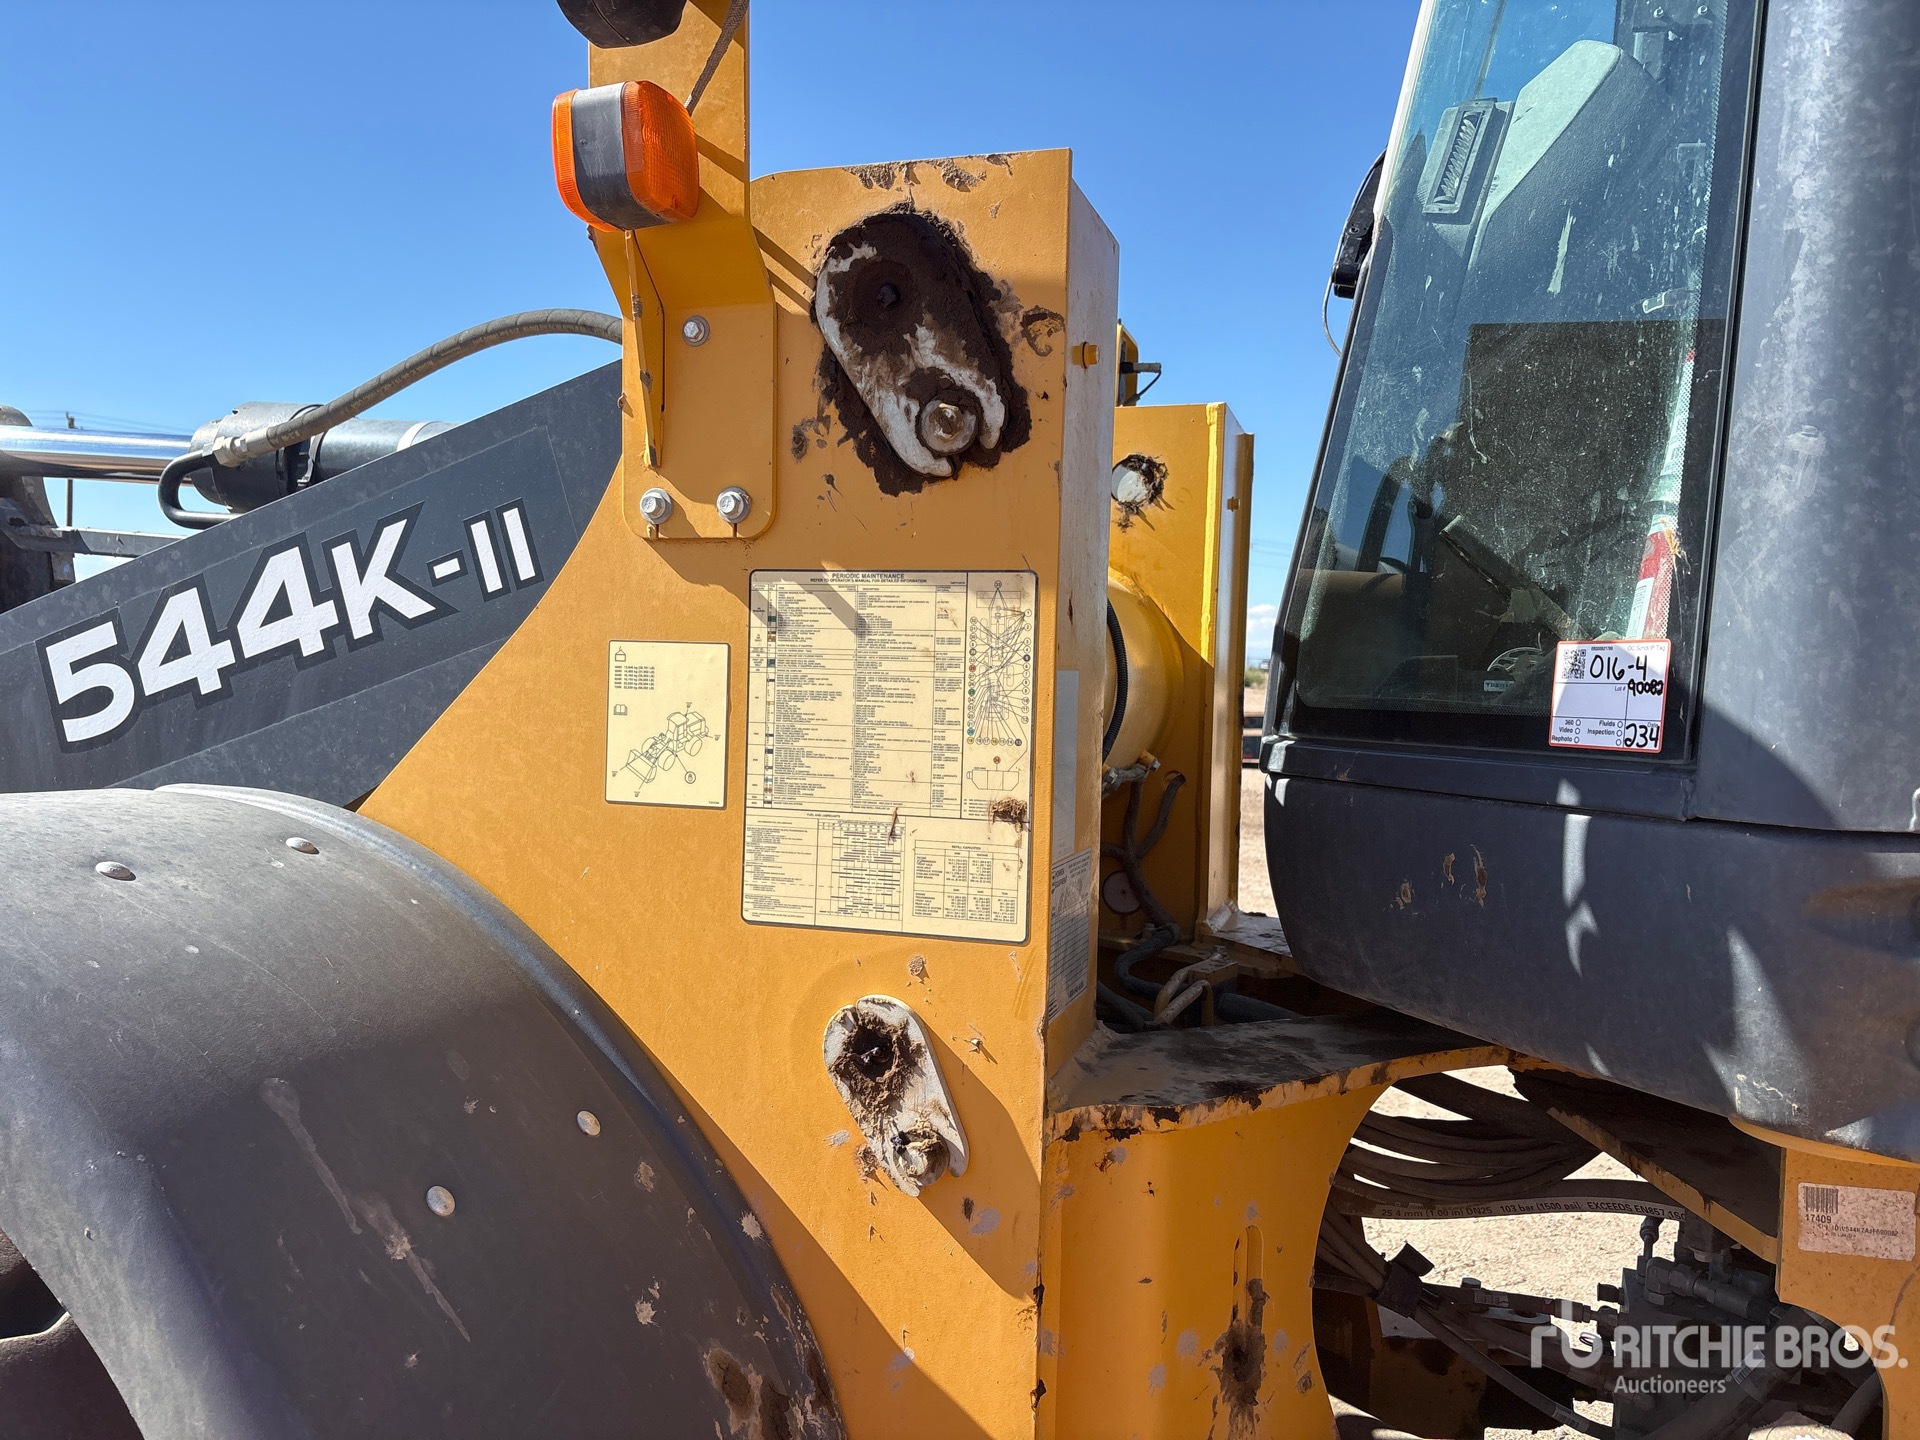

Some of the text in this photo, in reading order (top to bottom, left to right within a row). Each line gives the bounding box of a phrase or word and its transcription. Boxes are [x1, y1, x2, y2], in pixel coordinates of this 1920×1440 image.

[46, 506, 535, 743] 544K-II
[1590, 654, 1647, 681] 016-4
[1628, 678, 1664, 696] 90082
[1587, 728, 1615, 736] Inspection
[1537, 1202, 1561, 1211] (1500
[1564, 1202, 1580, 1210] psi)
[1587, 1202, 1633, 1212] EXCEEDS
[1634, 1205, 1664, 1216] EN857
[1805, 1214, 1832, 1223] 17409
